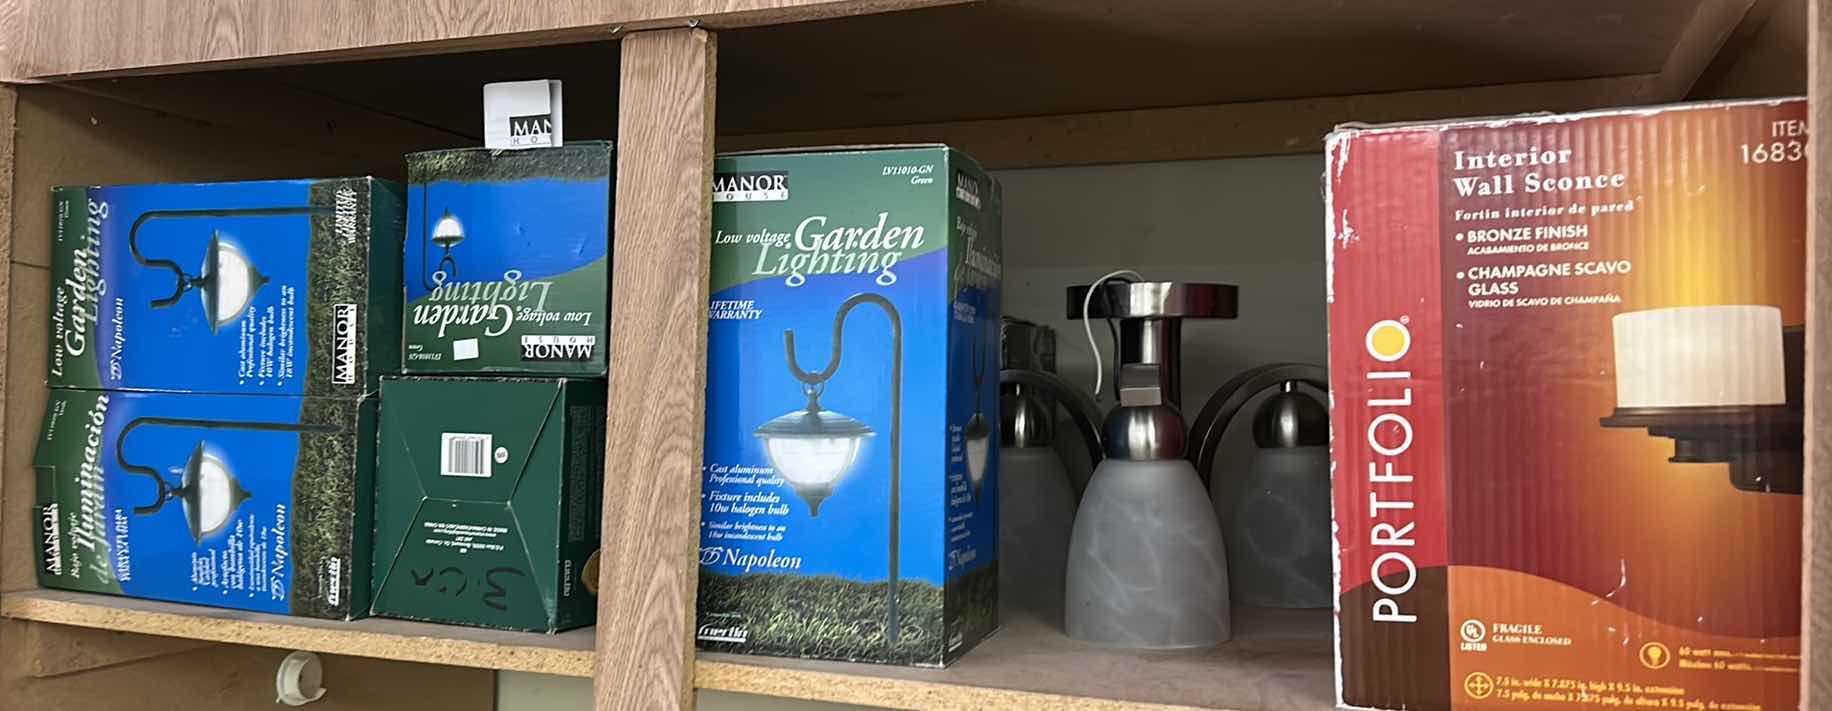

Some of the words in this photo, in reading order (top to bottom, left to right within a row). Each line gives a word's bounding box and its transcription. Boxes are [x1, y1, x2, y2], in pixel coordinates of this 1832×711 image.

[1454, 146, 1572, 169] Interior
[1454, 175, 1514, 197] Wall
[1525, 172, 1625, 192] Sconce
[1455, 208, 1500, 221] Fortin
[1505, 206, 1564, 218] interior
[1568, 203, 1585, 214] de
[1591, 200, 1634, 216] pared
[715, 231, 743, 244] Low
[746, 228, 791, 248] voltage
[794, 212, 924, 252] Garden
[1467, 227, 1531, 243] BRONZE
[1535, 224, 1588, 240] FINISH
[1536, 243, 1548, 252] DE
[82, 198, 109, 326] Lighting
[752, 238, 901, 287] Lighting
[1468, 263, 1570, 279] CHAMPAGNE
[1575, 260, 1631, 275] SCAVO
[429, 270, 552, 314] Lighting
[1468, 281, 1519, 296] GLASS
[53, 287, 68, 338] voltage
[65, 248, 88, 357] Garden
[710, 300, 755, 310] IFETIME
[1469, 299, 1500, 308] VIDRIO
[1502, 299, 1514, 307] DE
[1516, 297, 1548, 307] SCAVO
[1550, 297, 1562, 305] DE
[111, 297, 125, 359] Napoleon
[414, 304, 514, 337] Garden
[516, 307, 560, 326] voltage
[563, 311, 592, 326] Low
[336, 305, 349, 382] MANOR
[525, 344, 592, 358] MANOR
[52, 345, 64, 376] Low
[75, 394, 110, 552] Iluminación
[710, 463, 728, 473] Cast
[1366, 319, 1417, 623] PORTFOLIO
[709, 490, 742, 501] Fixture
[743, 492, 780, 503] includes
[731, 503, 766, 517] halogen
[768, 504, 790, 516] bulb
[271, 504, 288, 577] Napoleon
[722, 548, 802, 573] Napoleon
[1493, 623, 1543, 634] FRAGILE
